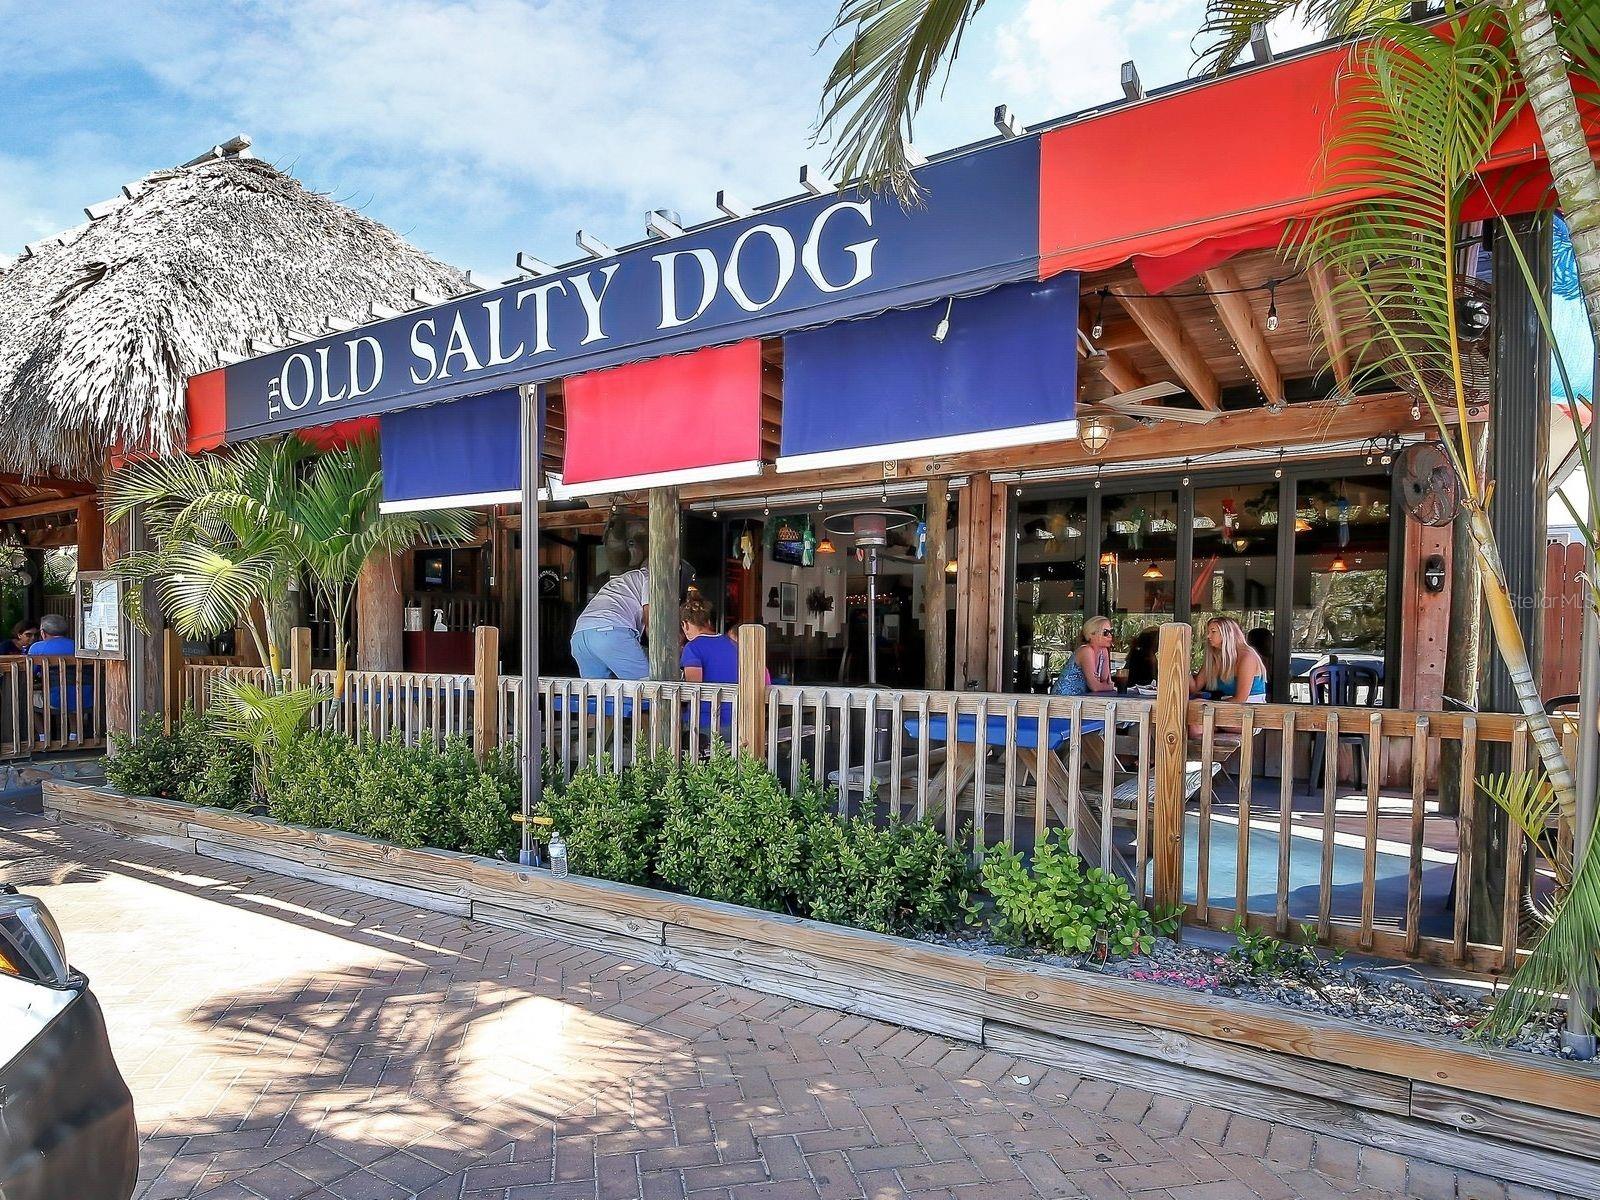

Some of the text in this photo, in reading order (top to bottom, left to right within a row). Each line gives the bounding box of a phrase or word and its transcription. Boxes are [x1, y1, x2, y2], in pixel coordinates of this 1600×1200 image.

[280, 336, 384, 411] OLD
[409, 262, 621, 386] SALTY
[651, 198, 879, 330] DOG
